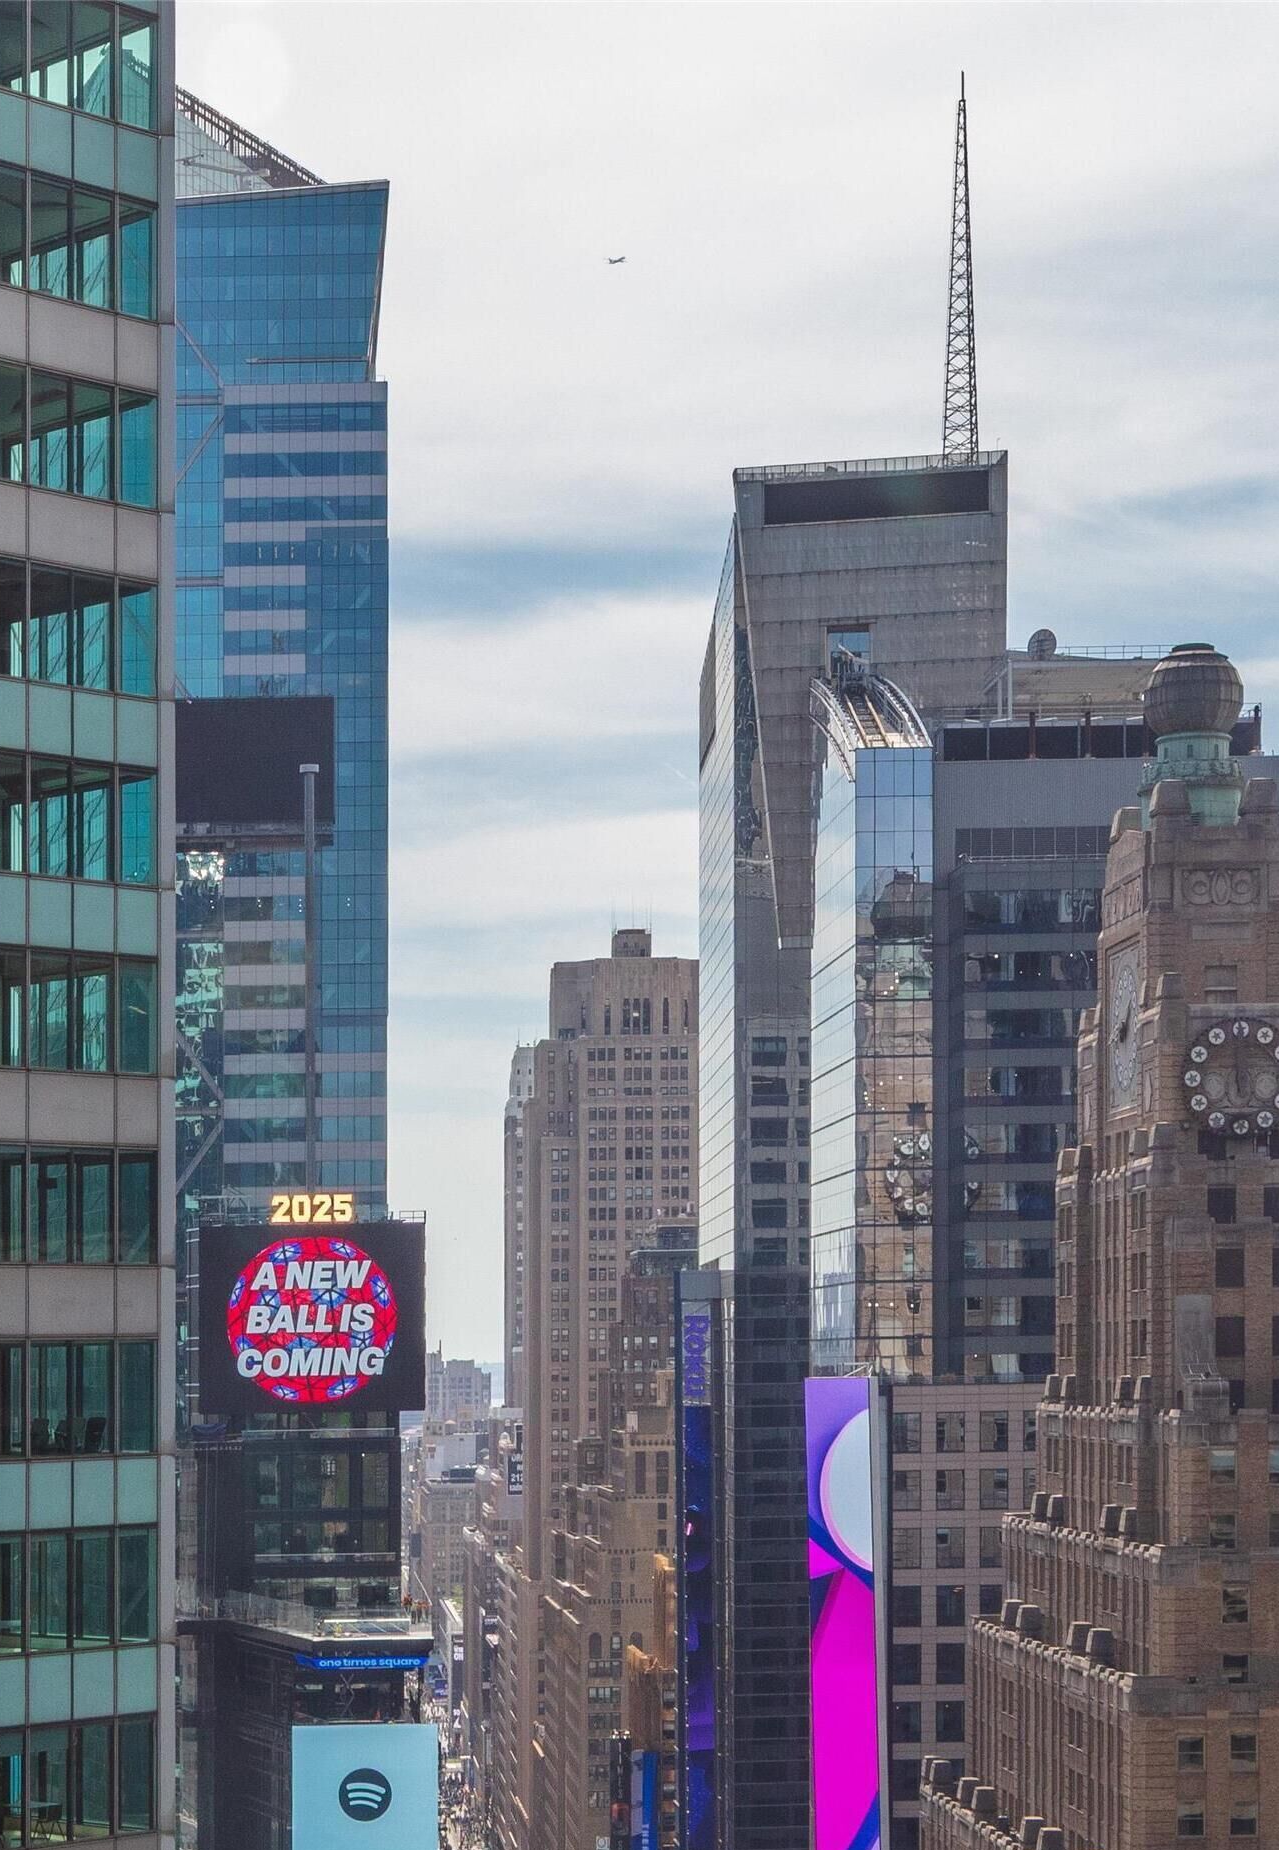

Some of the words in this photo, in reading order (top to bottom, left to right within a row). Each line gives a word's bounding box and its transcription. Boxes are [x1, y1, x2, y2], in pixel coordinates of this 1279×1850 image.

[271, 1194, 353, 1223] 2025
[250, 1261, 277, 1290] A
[285, 1260, 372, 1289] NEW
[246, 1304, 332, 1334] BALL
[339, 1303, 375, 1332] IS
[237, 1346, 386, 1378] COMING
[319, 1659, 341, 1667] one
[343, 1658, 376, 1667] times
[379, 1657, 421, 1669] square
